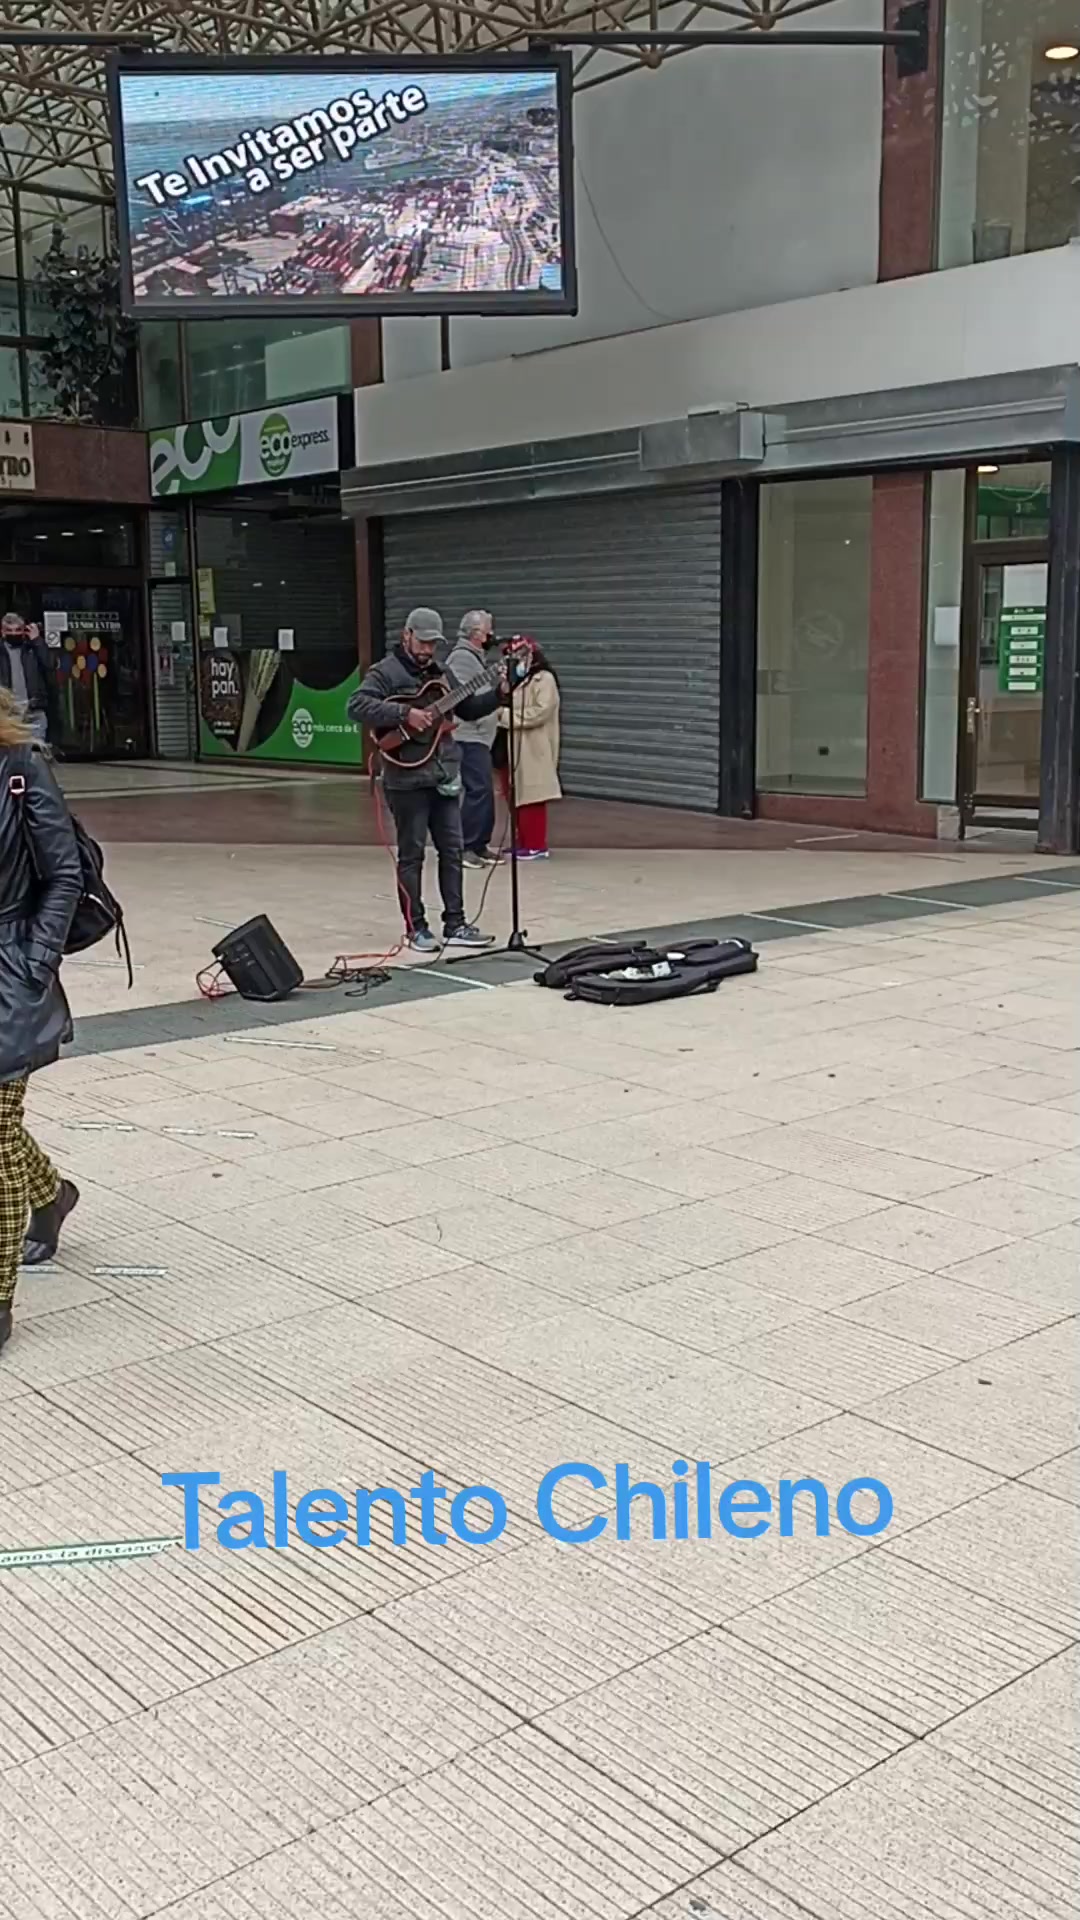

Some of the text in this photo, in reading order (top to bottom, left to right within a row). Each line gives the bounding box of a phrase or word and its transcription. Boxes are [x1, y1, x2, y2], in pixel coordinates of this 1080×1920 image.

[136, 89, 375, 204] Te Invitamos
[247, 85, 426, 192] a ser parte
[260, 429, 331, 459] eco express
[211, 657, 234, 680] hay
[211, 679, 239, 699] pan.
